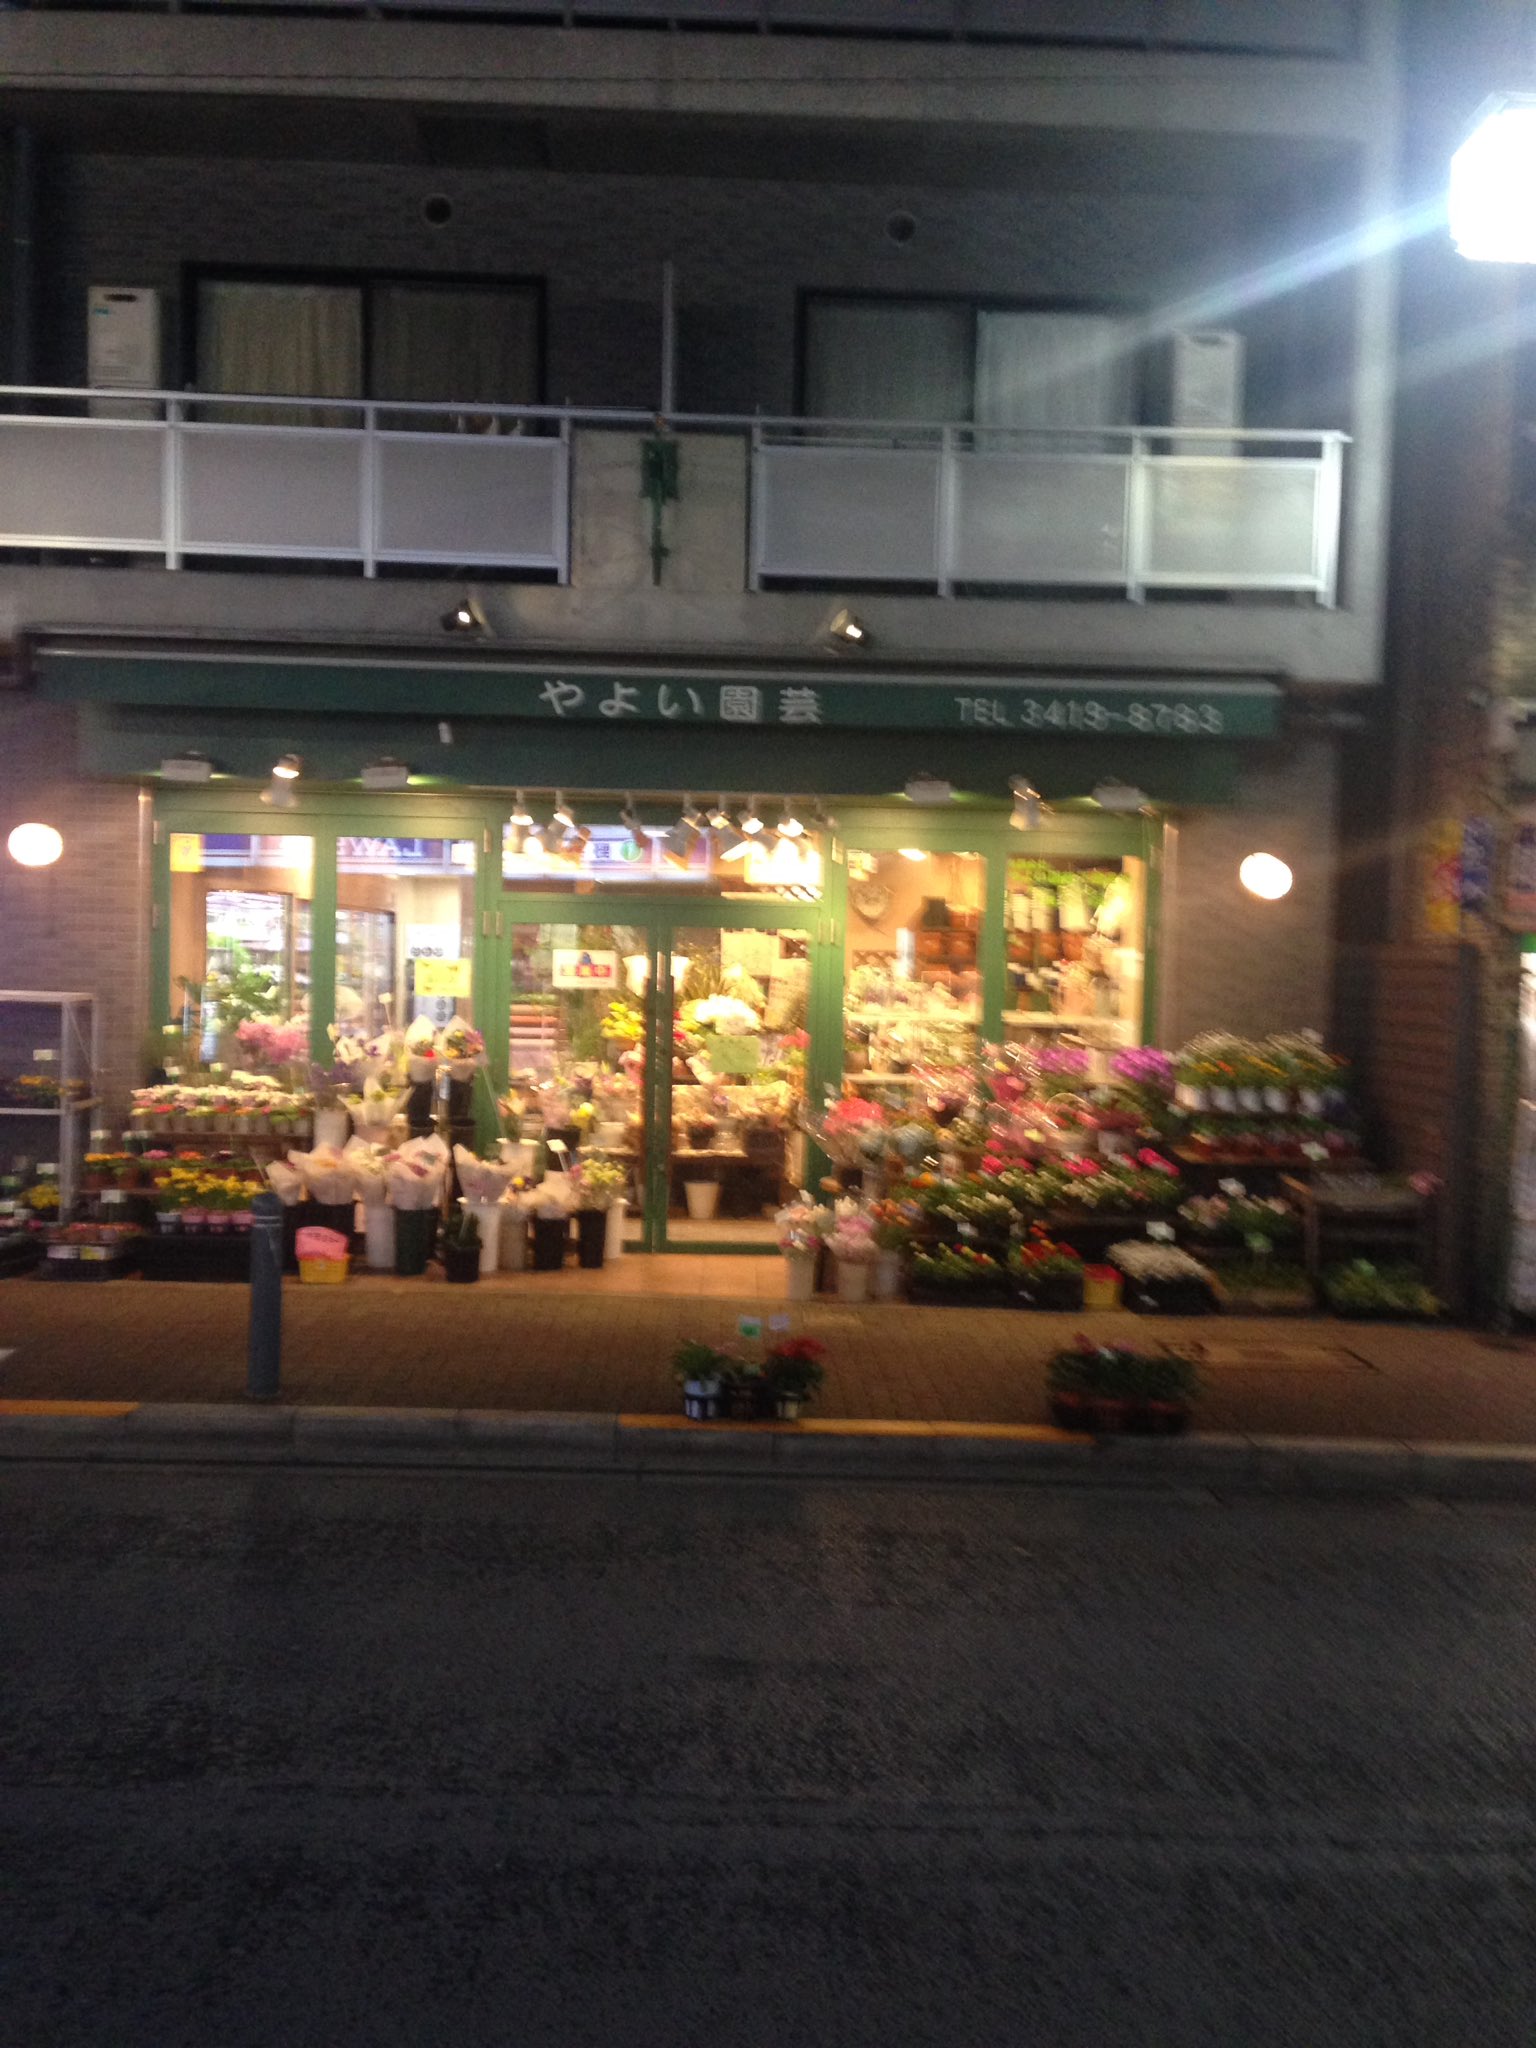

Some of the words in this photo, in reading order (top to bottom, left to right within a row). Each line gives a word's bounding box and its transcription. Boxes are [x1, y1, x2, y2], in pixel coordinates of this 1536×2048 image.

[538, 679, 823, 725] やよい園芸
[954, 697, 1014, 727] TEL
